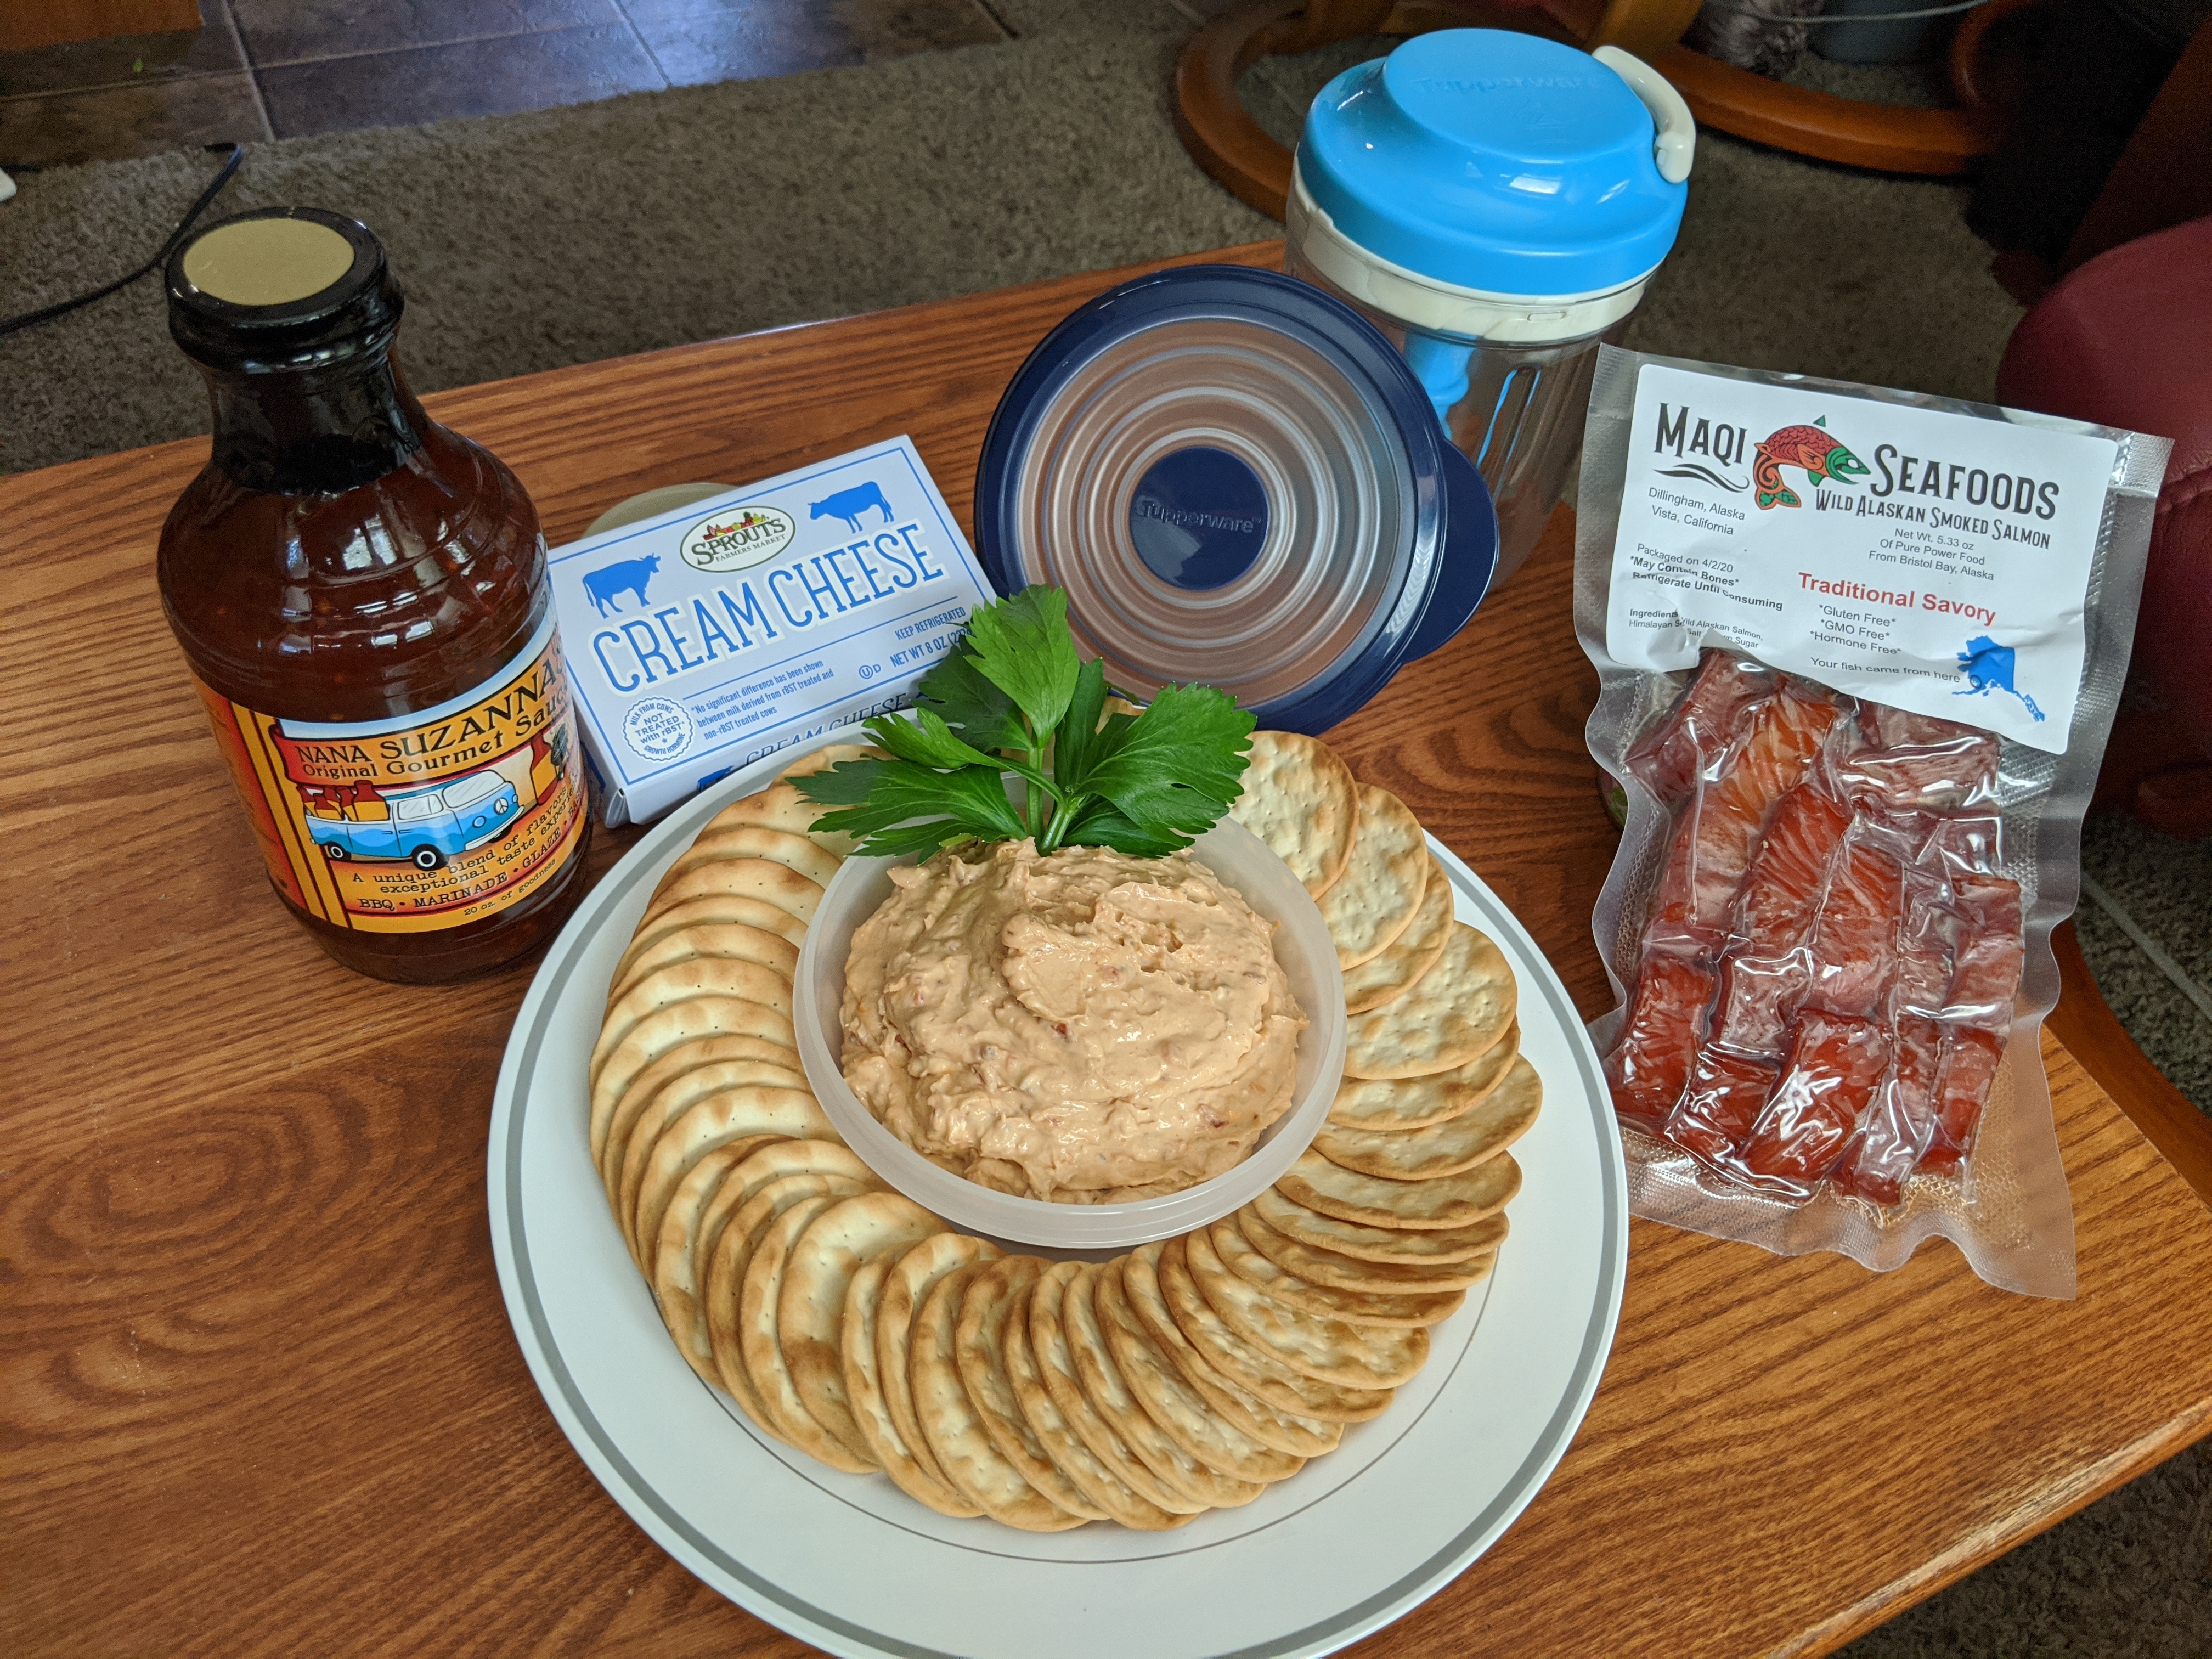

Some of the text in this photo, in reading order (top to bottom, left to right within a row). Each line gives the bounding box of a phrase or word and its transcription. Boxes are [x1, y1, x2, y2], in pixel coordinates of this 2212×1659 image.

[1653, 402, 2061, 520] MAQI SEAFOODS
[1649, 487, 1745, 521] Dillingham, Alaska
[1815, 489, 2051, 549] WILD ALASKAN SMOKED SALMON
[1652, 505, 1734, 535] Vista, California
[691, 518, 786, 566] SPROUTS
[716, 534, 786, 562] FARMERS MARKET
[1880, 539, 1985, 565] Of Pure Power Food
[1894, 528, 1974, 551] Net Wt. 5.33 oz
[1637, 543, 1683, 563] Packaged
[1702, 558, 1734, 573] 4/2/20
[1657, 562, 1698, 576] Contain
[1869, 550, 1994, 580] From Bristol Bay, Alaska
[1633, 572, 1783, 611] Refrigerate Until Consuming
[1799, 572, 1996, 627] Traditional Savory
[593, 523, 944, 692] CREAM CHEESE
[895, 607, 966, 641] KEEP REFRIGERATED
[1629, 620, 1672, 630] Himalayan
[1696, 620, 1729, 631] Alaskan
[1732, 626, 1763, 641] Salmon,
[889, 650, 909, 668] NET
[908, 645, 925, 659] WT
[925, 642, 933, 654] 8
[933, 636, 948, 651] OZ
[1735, 635, 1759, 648] Sugar
[706, 690, 741, 710] significant
[741, 679, 775, 697] difference
[774, 674, 787, 685] has
[786, 668, 803, 679] been
[803, 660, 825, 673] shown
[1811, 658, 1838, 669] Your
[1842, 662, 1862, 672] fish
[1903, 667, 1931, 676] from
[1934, 671, 1960, 682] here
[696, 668, 835, 728] between milk derived from rBST treated and
[630, 703, 674, 726] MILK FROM COWS
[635, 715, 680, 737] TREATED
[643, 713, 663, 725] NOT
[703, 706, 778, 740] non-rBST treated cows
[640, 732, 660, 744] with
[644, 732, 685, 755] GROWTH HORMONE
[297, 745, 373, 764] NANA
[303, 763, 379, 780] Original
[387, 730, 504, 775] Gourmet
[352, 786, 568, 884] A unique blend of flavors
[357, 898, 396, 911] BBQ
[413, 872, 508, 908] MARINADE
[522, 827, 561, 868] GLAZE
[380, 865, 489, 894] exceptional
[496, 837, 535, 865] taste
[464, 907, 478, 916] 20
[501, 891, 514, 901] of
[518, 859, 556, 893] goodness
